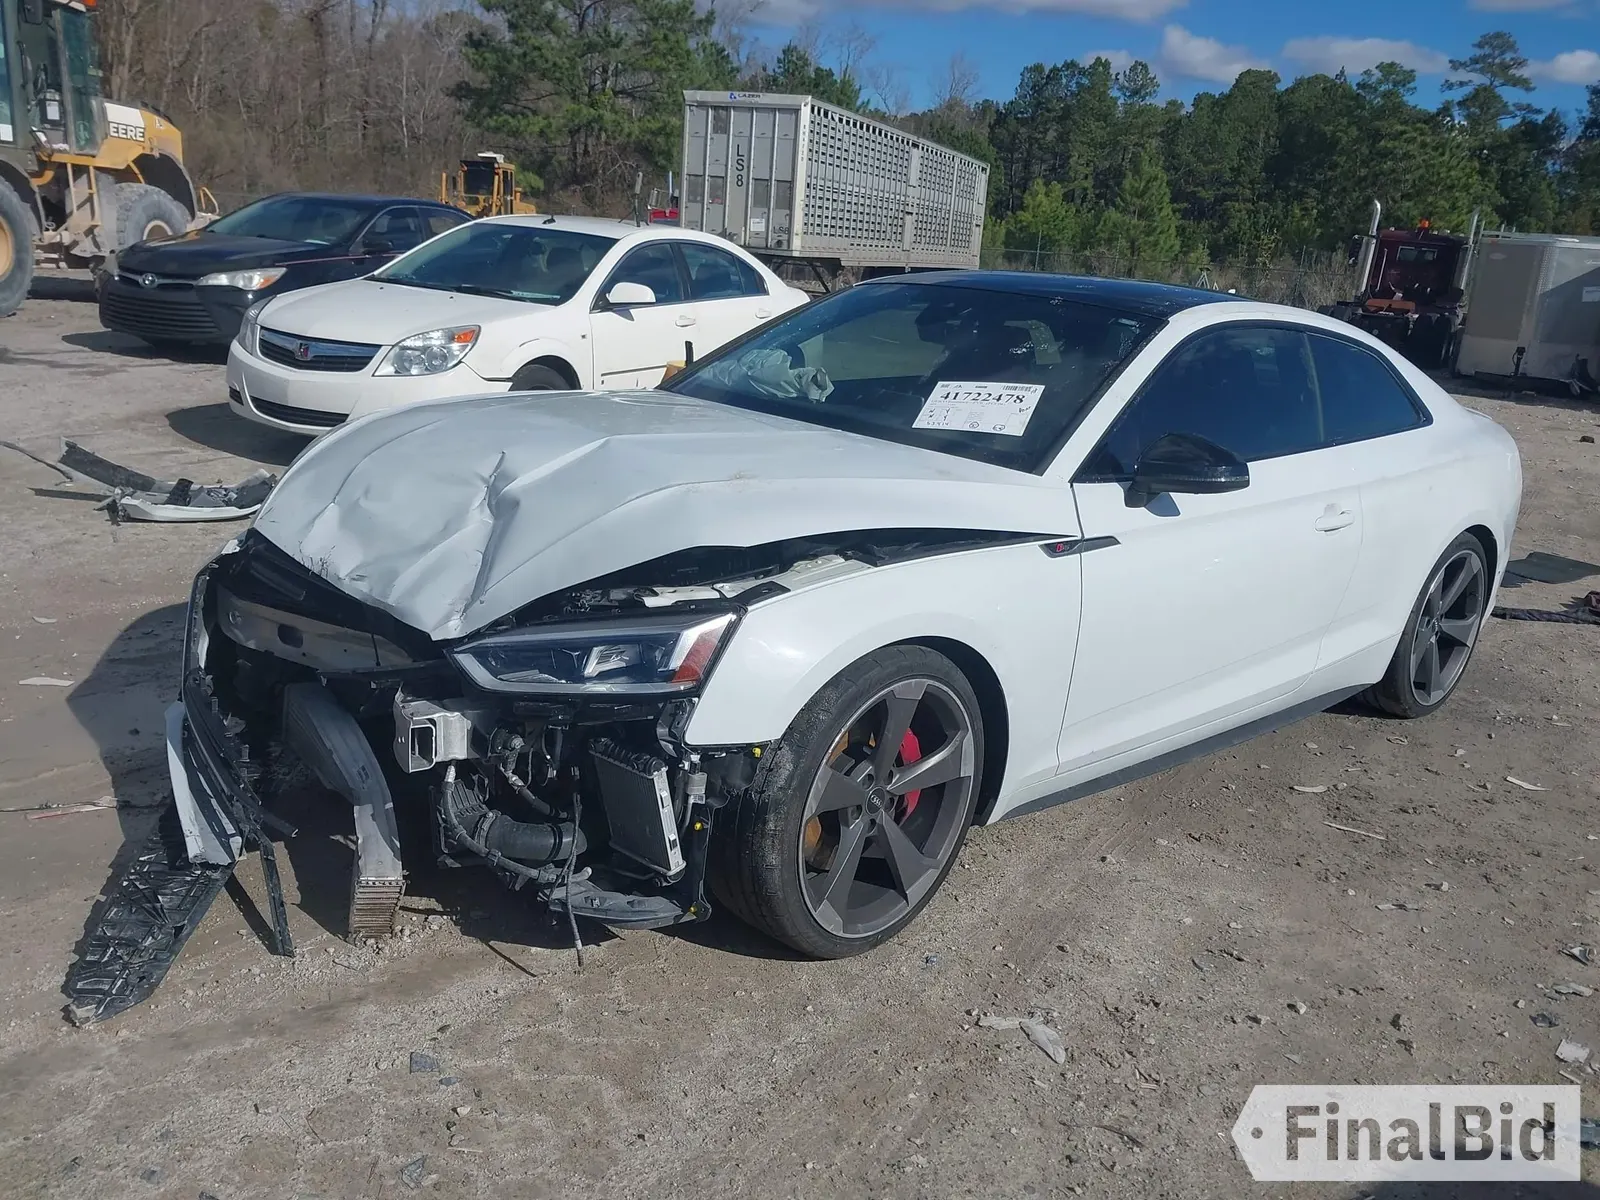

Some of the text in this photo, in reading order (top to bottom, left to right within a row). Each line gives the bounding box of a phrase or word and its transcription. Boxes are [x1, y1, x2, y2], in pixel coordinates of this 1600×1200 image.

[109, 122, 145, 142] EERE
[735, 143, 745, 188] LS8
[940, 391, 1026, 405] 41722478
